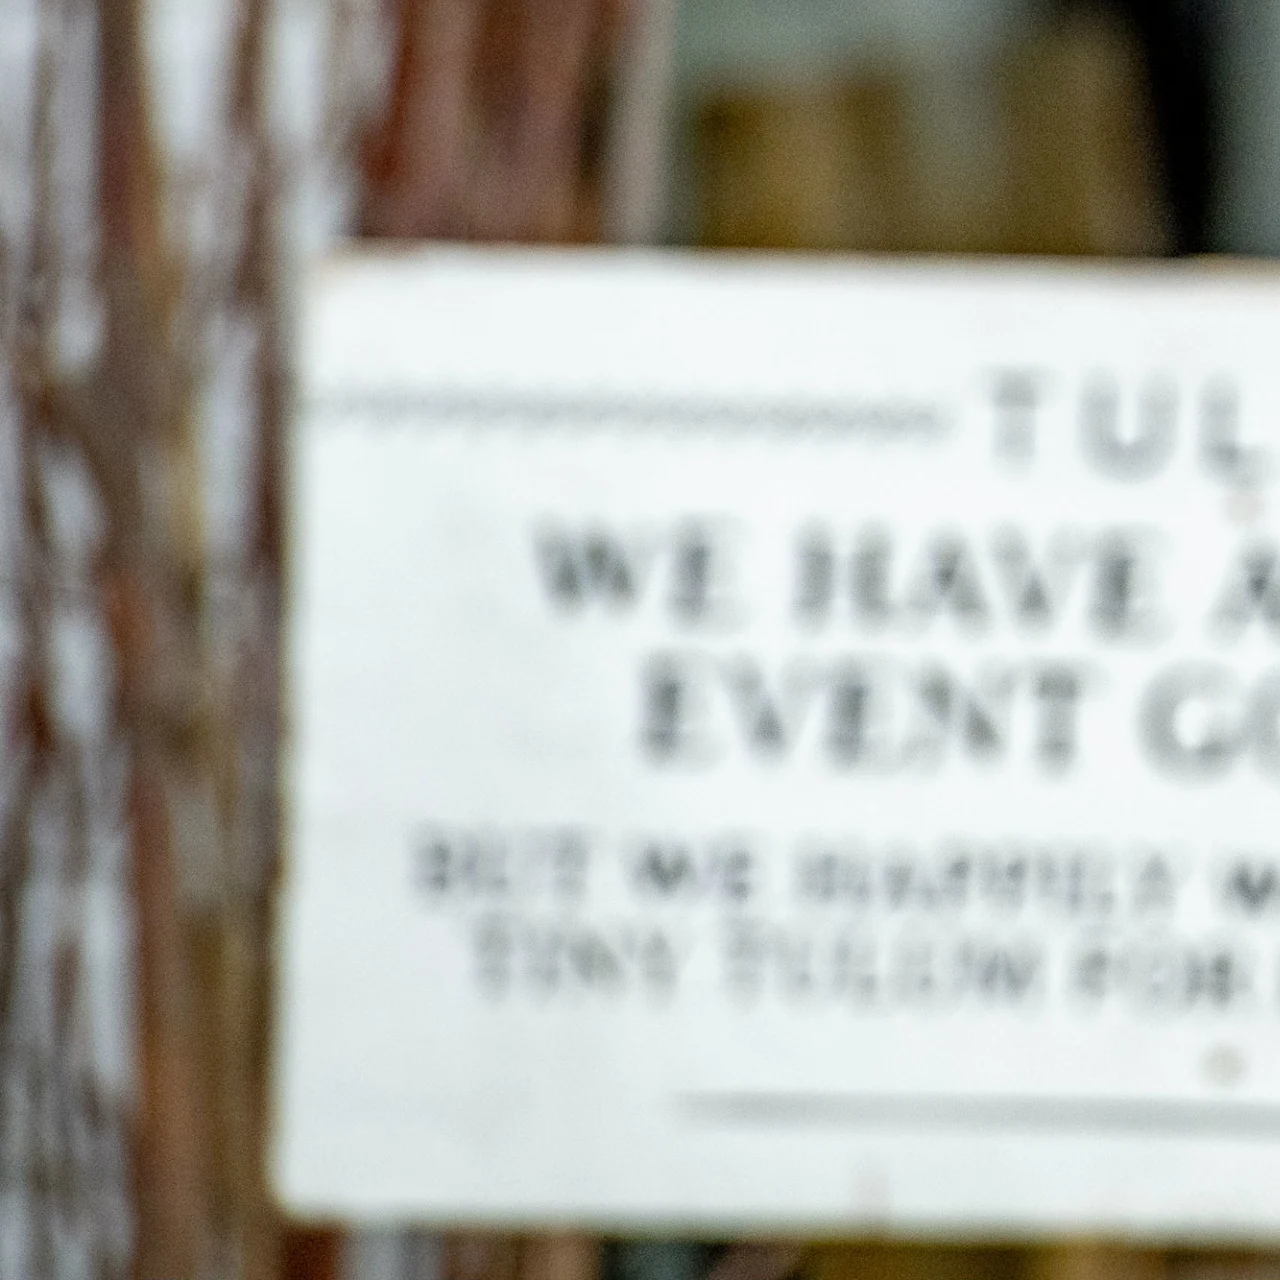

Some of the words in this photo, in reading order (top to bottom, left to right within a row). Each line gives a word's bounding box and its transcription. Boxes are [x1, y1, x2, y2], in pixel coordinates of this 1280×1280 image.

[532, 520, 744, 630] WE
[792, 522, 1176, 646] HAVE
[638, 646, 1105, 780] EVENT
